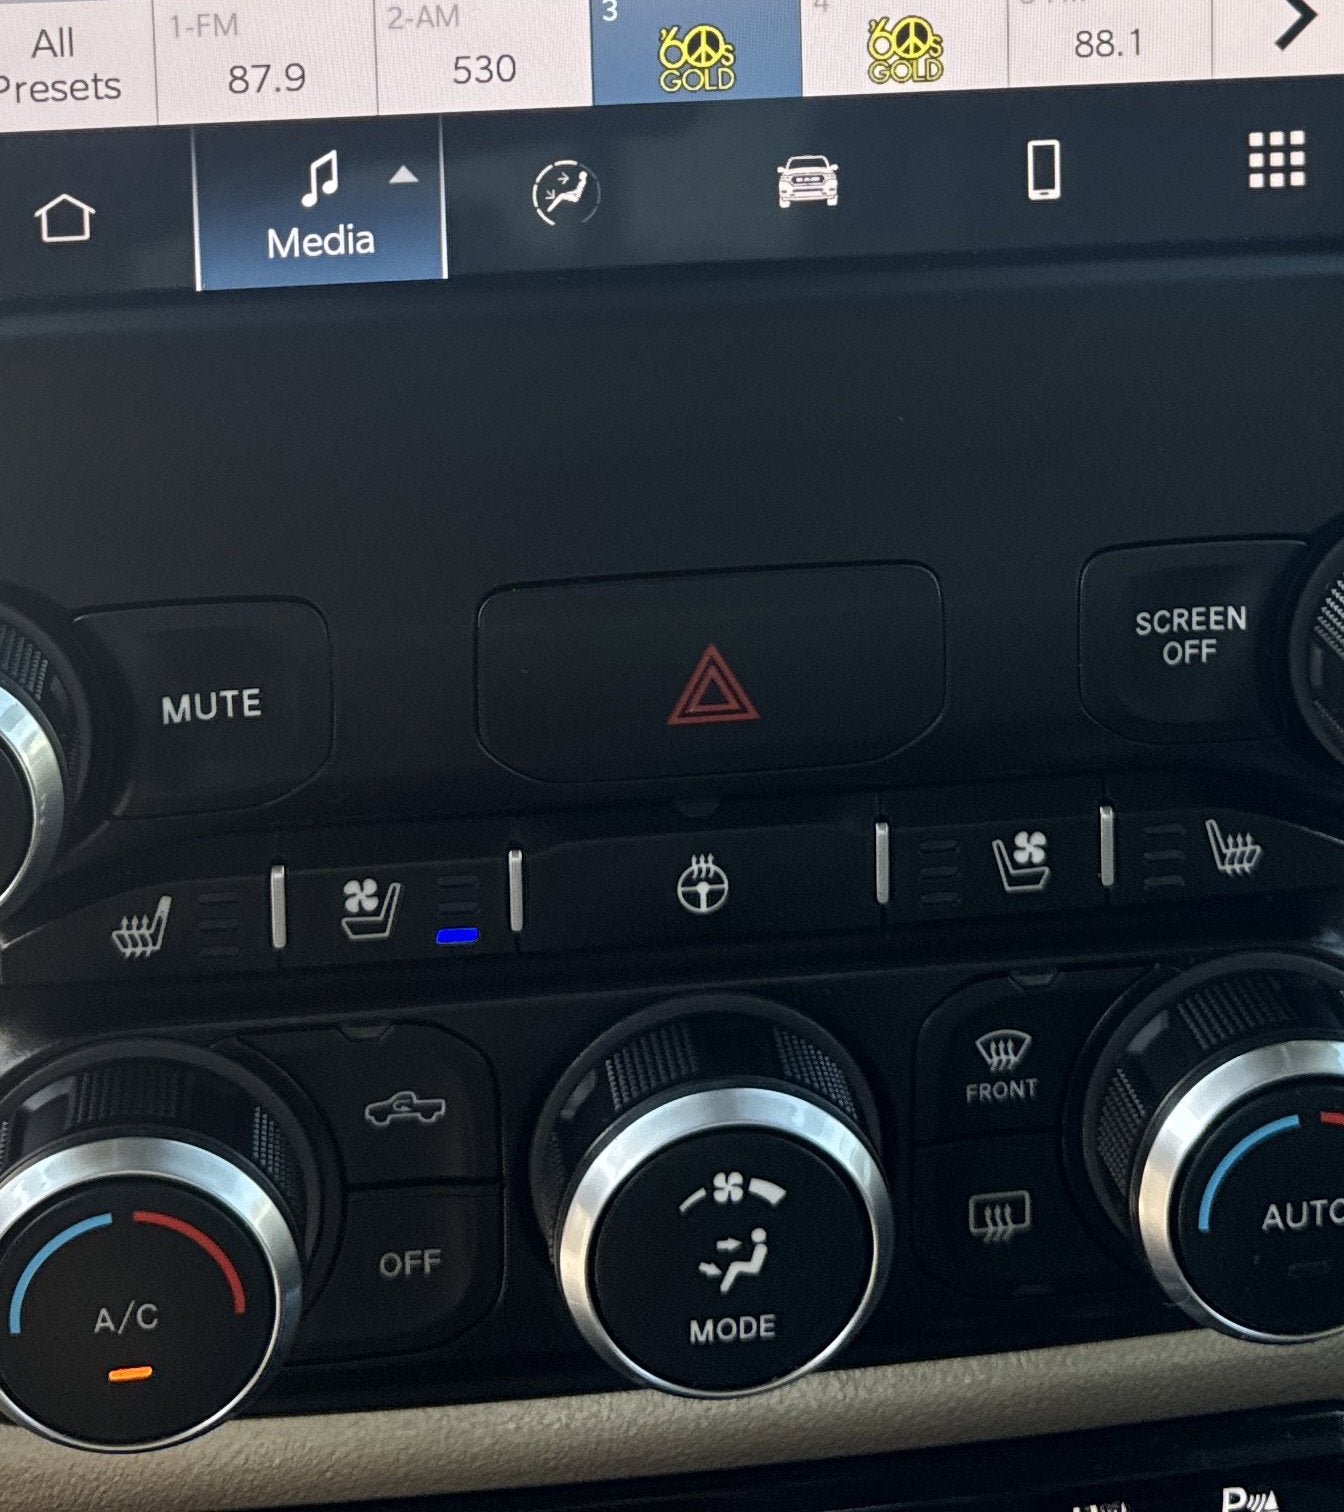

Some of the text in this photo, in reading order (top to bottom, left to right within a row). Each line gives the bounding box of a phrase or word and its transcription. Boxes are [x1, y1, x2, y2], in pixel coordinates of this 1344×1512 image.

[171, 12, 240, 40] 1-FM
[386, 3, 461, 31] 2-AM
[31, 26, 76, 59] All
[1074, 28, 1144, 59] 88.1
[228, 62, 307, 96] 87.9
[452, 53, 518, 86] 530
[658, 67, 737, 94] GOLD
[867, 58, 945, 85] GOLD
[266, 224, 376, 260] Media
[1135, 604, 1248, 635] SCREEN
[1162, 638, 1218, 667] OFF
[161, 688, 262, 725] MUTE
[965, 1076, 1039, 1104] FRONT
[379, 1248, 442, 1277] OFF
[94, 1301, 159, 1337] A/C
[689, 1314, 776, 1345] MODE
